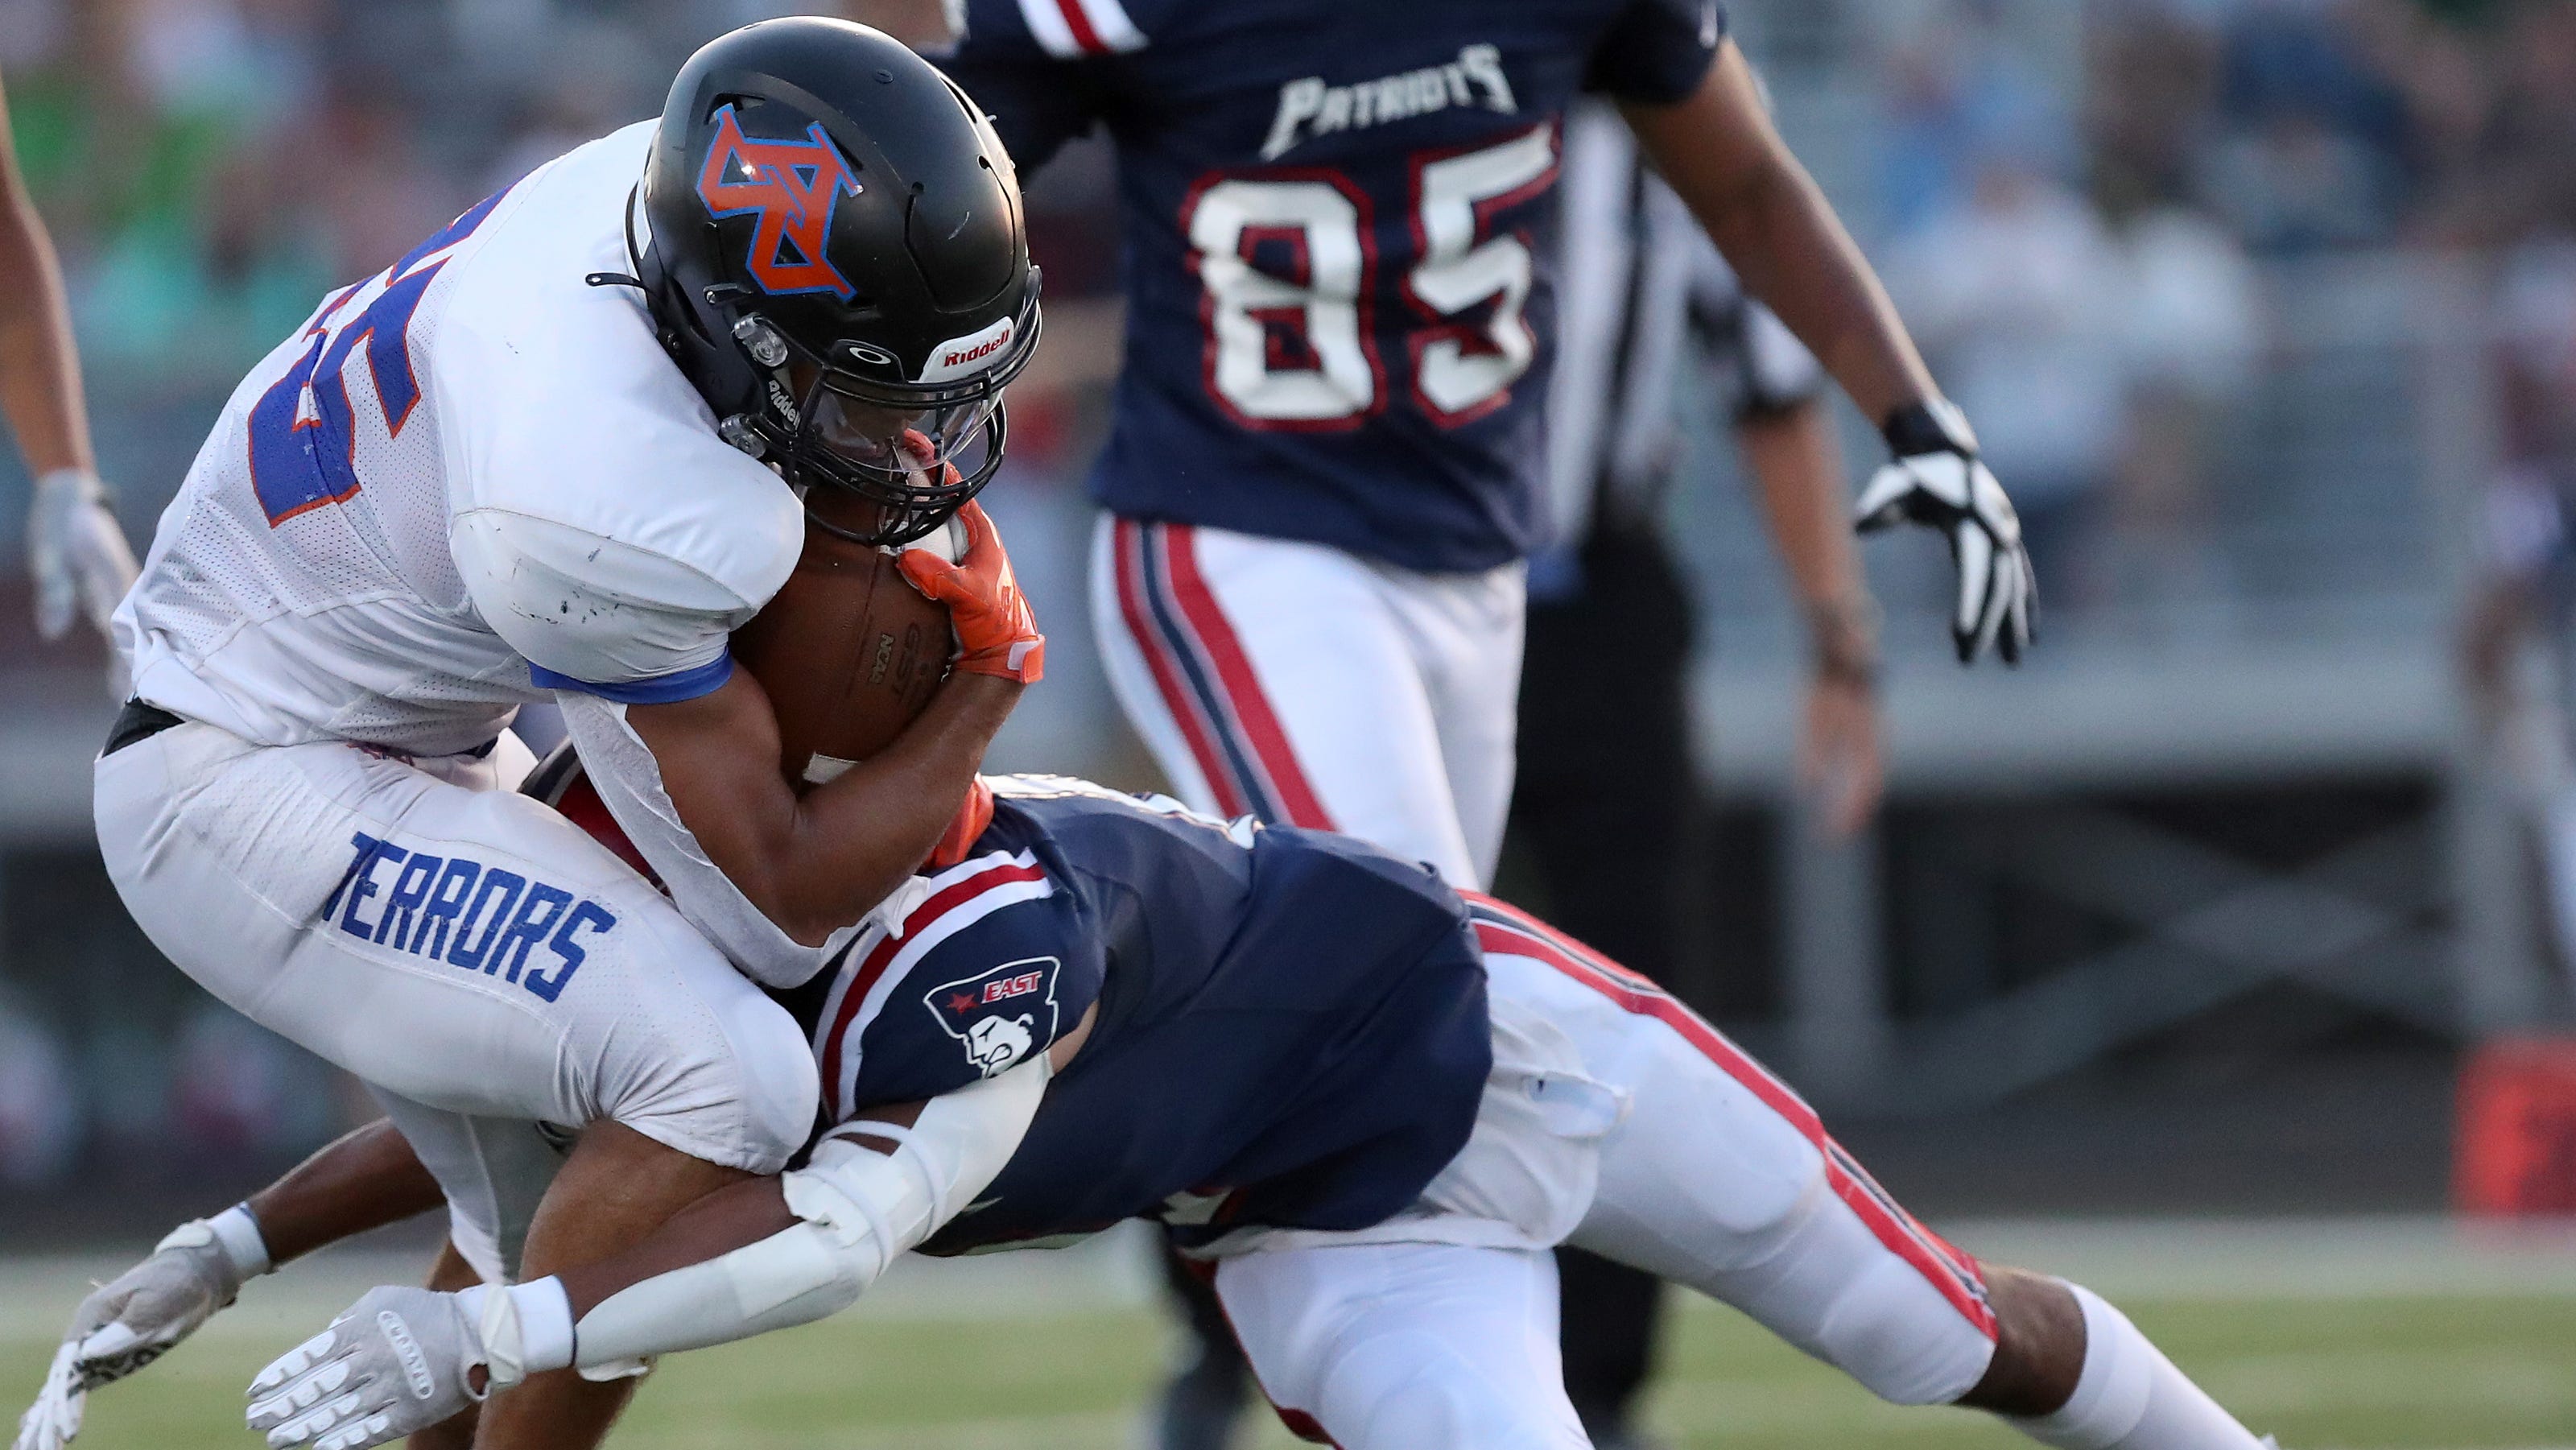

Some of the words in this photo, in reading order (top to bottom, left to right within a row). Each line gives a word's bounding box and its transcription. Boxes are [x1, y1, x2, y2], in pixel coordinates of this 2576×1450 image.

[1179, 119, 1560, 432] 85
[944, 328, 1010, 367] Riddell
[322, 831, 617, 1004] TERRORS
[981, 970, 1043, 1004] EAST
